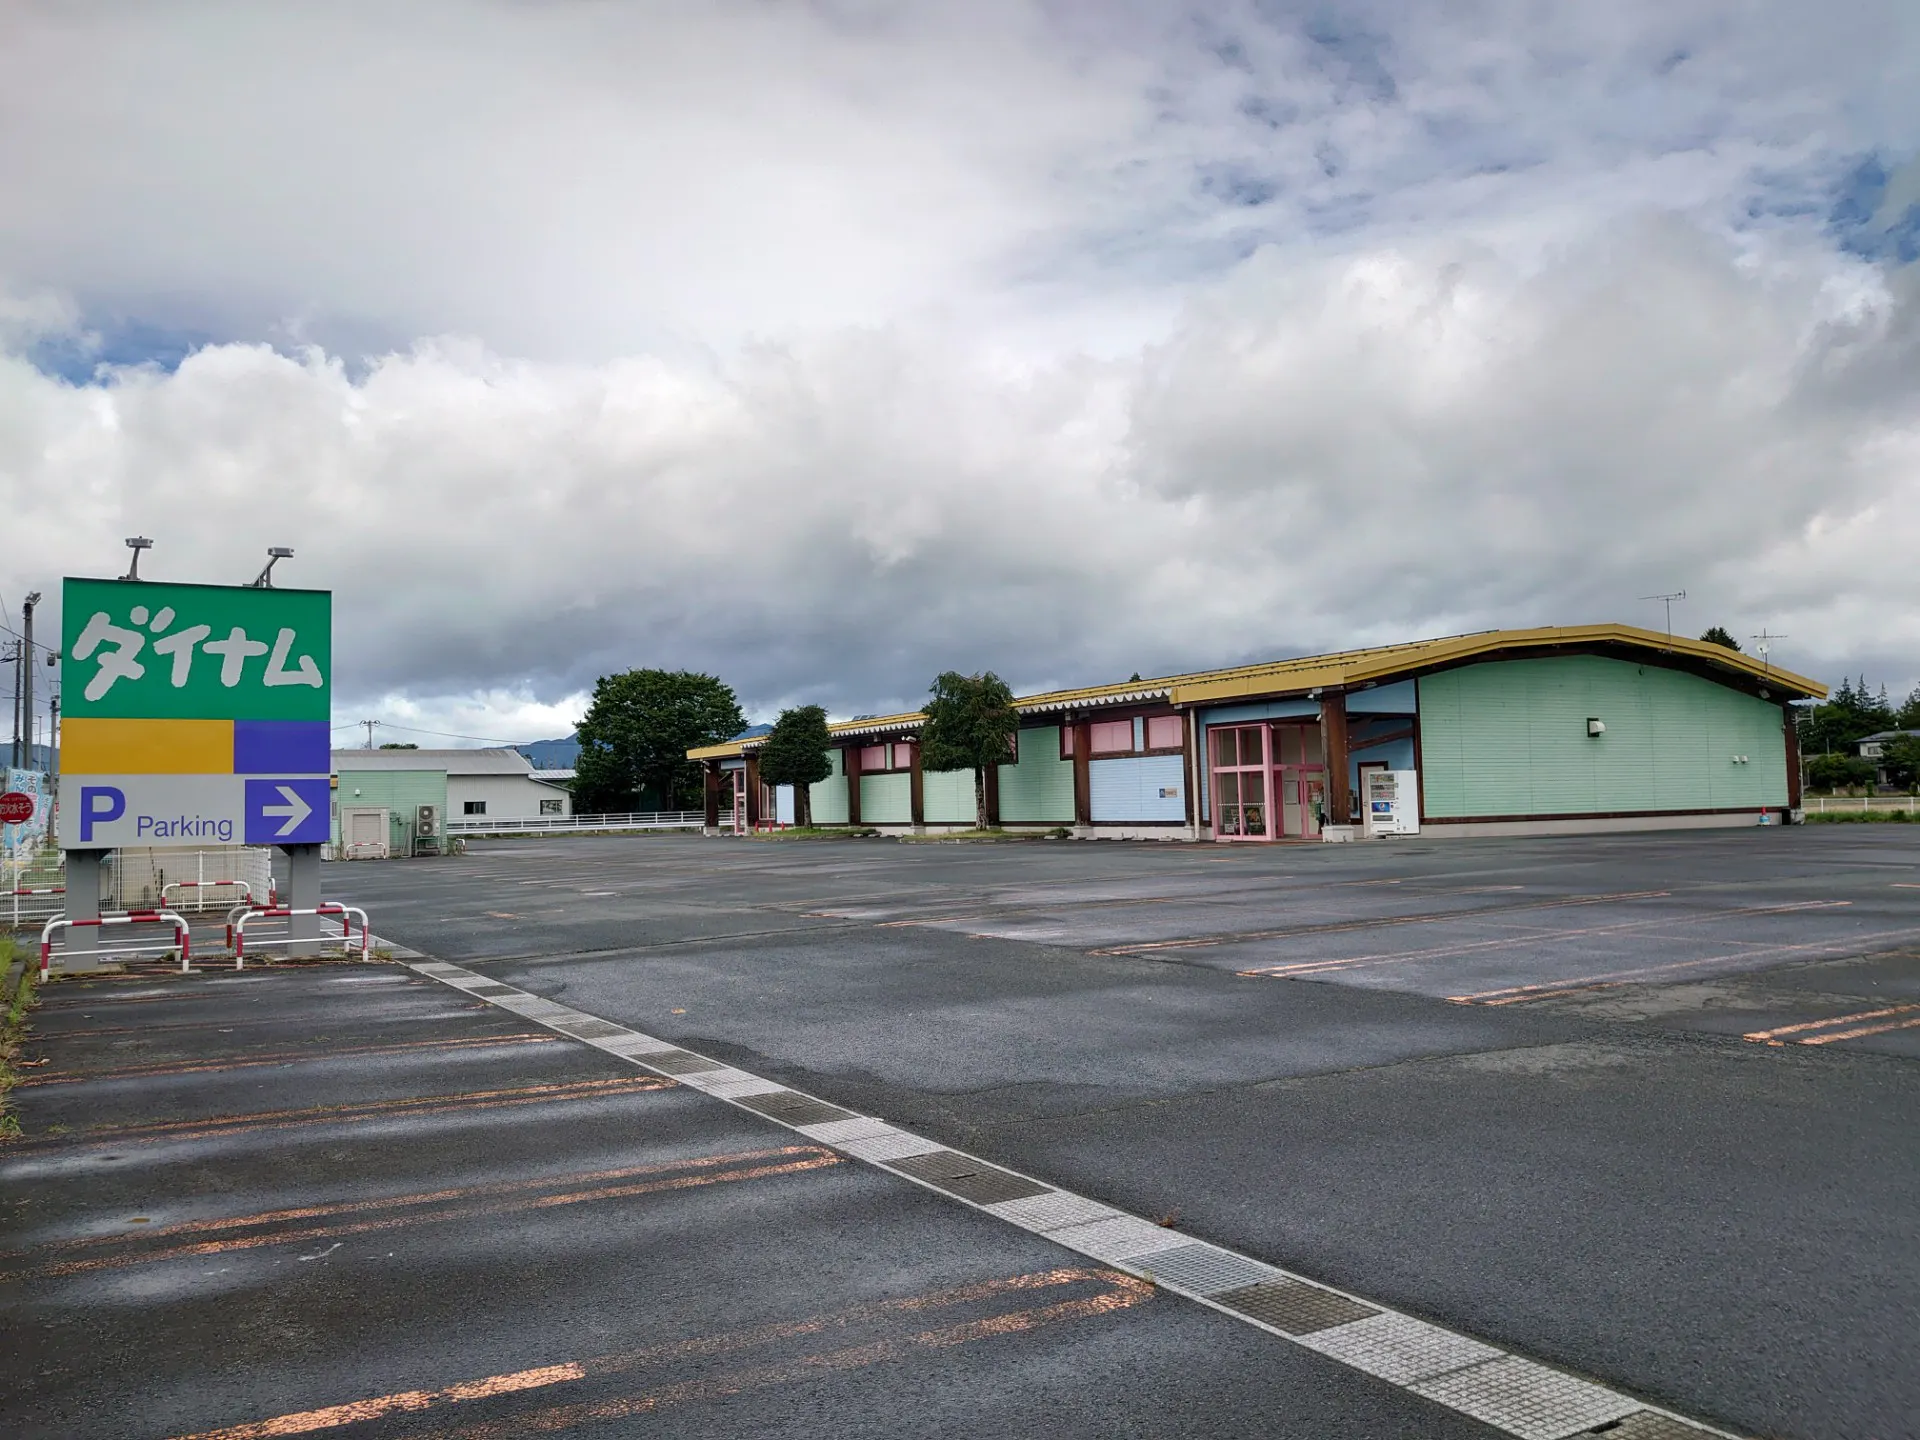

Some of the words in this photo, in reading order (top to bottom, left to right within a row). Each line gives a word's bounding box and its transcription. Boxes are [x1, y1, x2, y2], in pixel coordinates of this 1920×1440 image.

[72, 605, 323, 701] ダイナム
[80, 786, 126, 842] P
[137, 815, 233, 841] Parking
